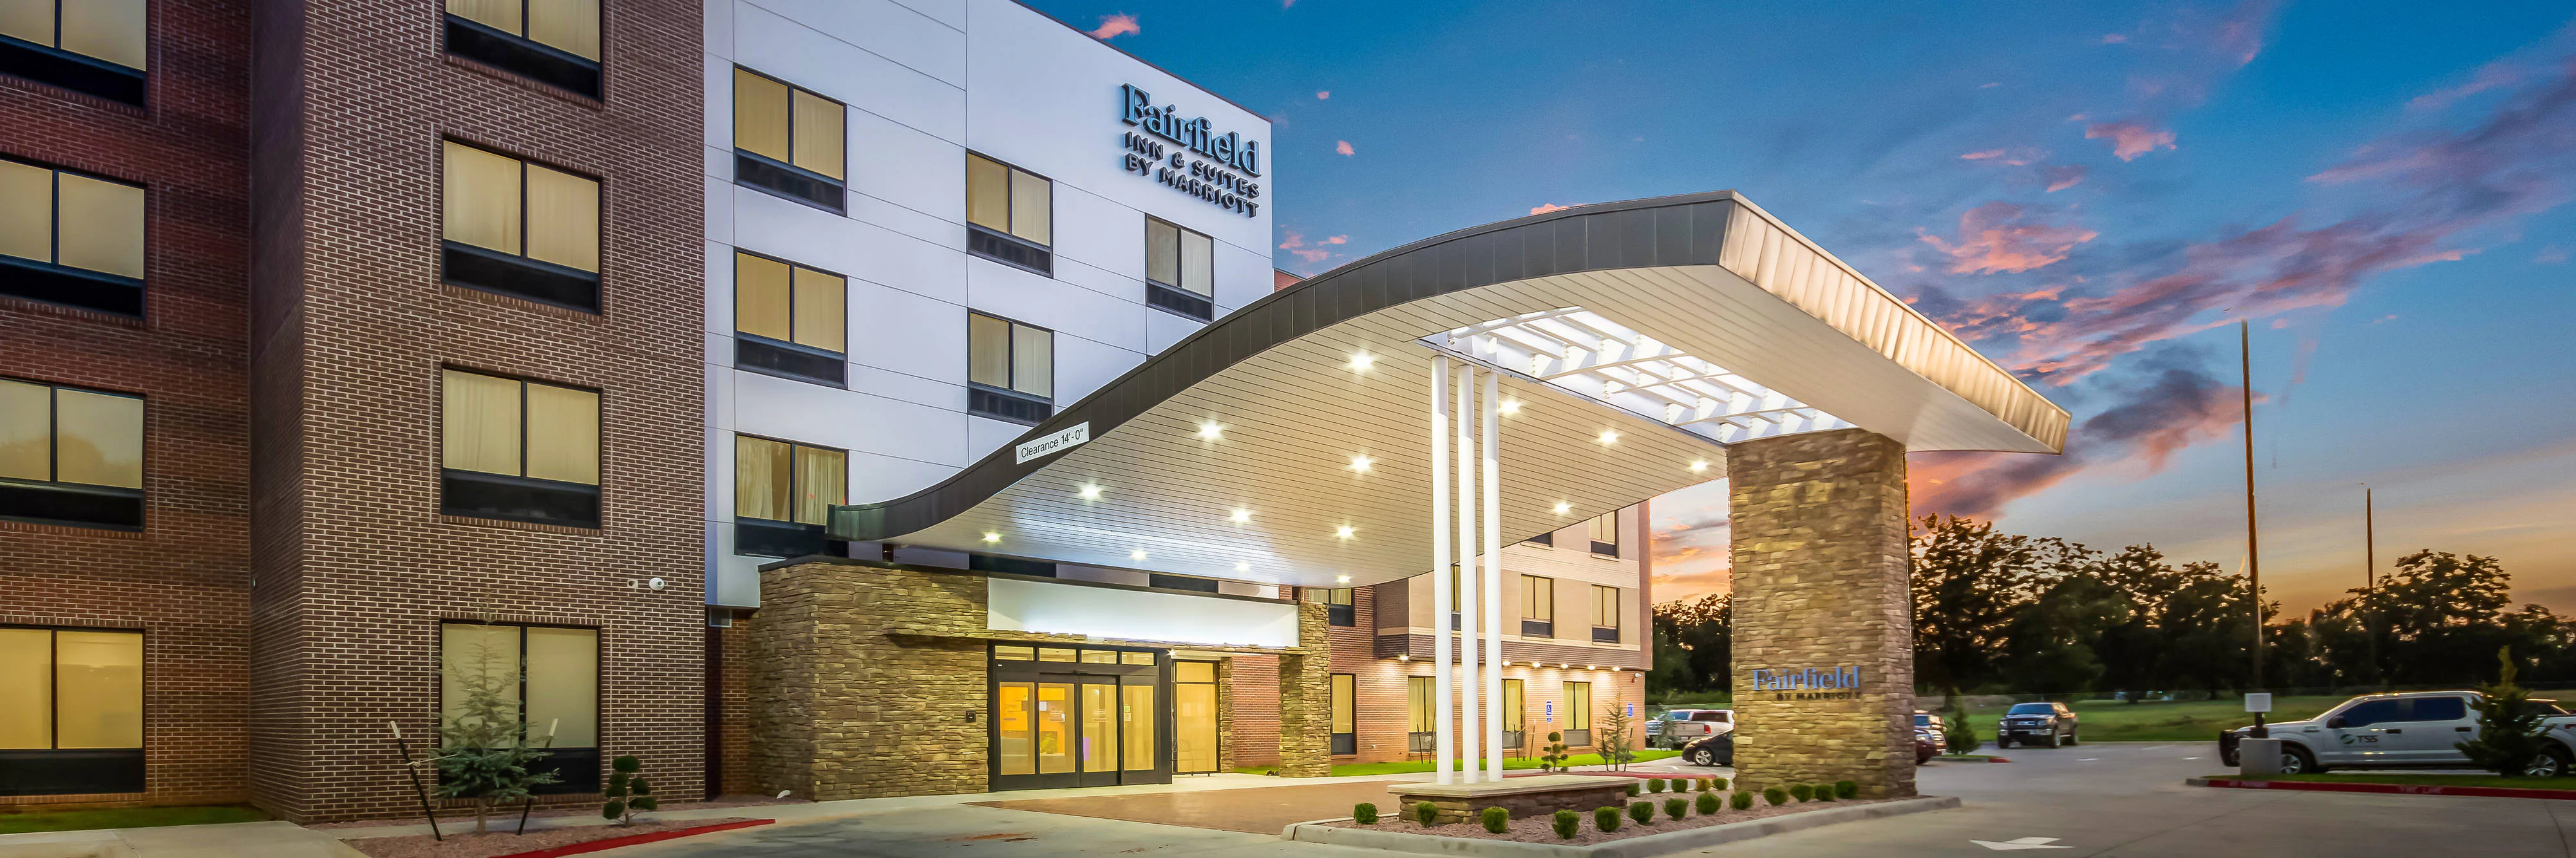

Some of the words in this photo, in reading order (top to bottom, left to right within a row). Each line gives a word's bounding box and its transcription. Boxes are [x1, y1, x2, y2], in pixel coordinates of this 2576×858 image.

[1121, 83, 1262, 178] Fairfield
[1124, 131, 1164, 161] INN
[1171, 151, 1185, 169] &
[1191, 160, 1260, 199] SUITES
[1124, 153, 1153, 176] BY
[1159, 167, 1260, 218] MARRIOTT
[1021, 438, 1059, 458] Clearance
[1752, 666, 1860, 691] Fairfield
[1797, 692, 1862, 700] MARRIOTT
